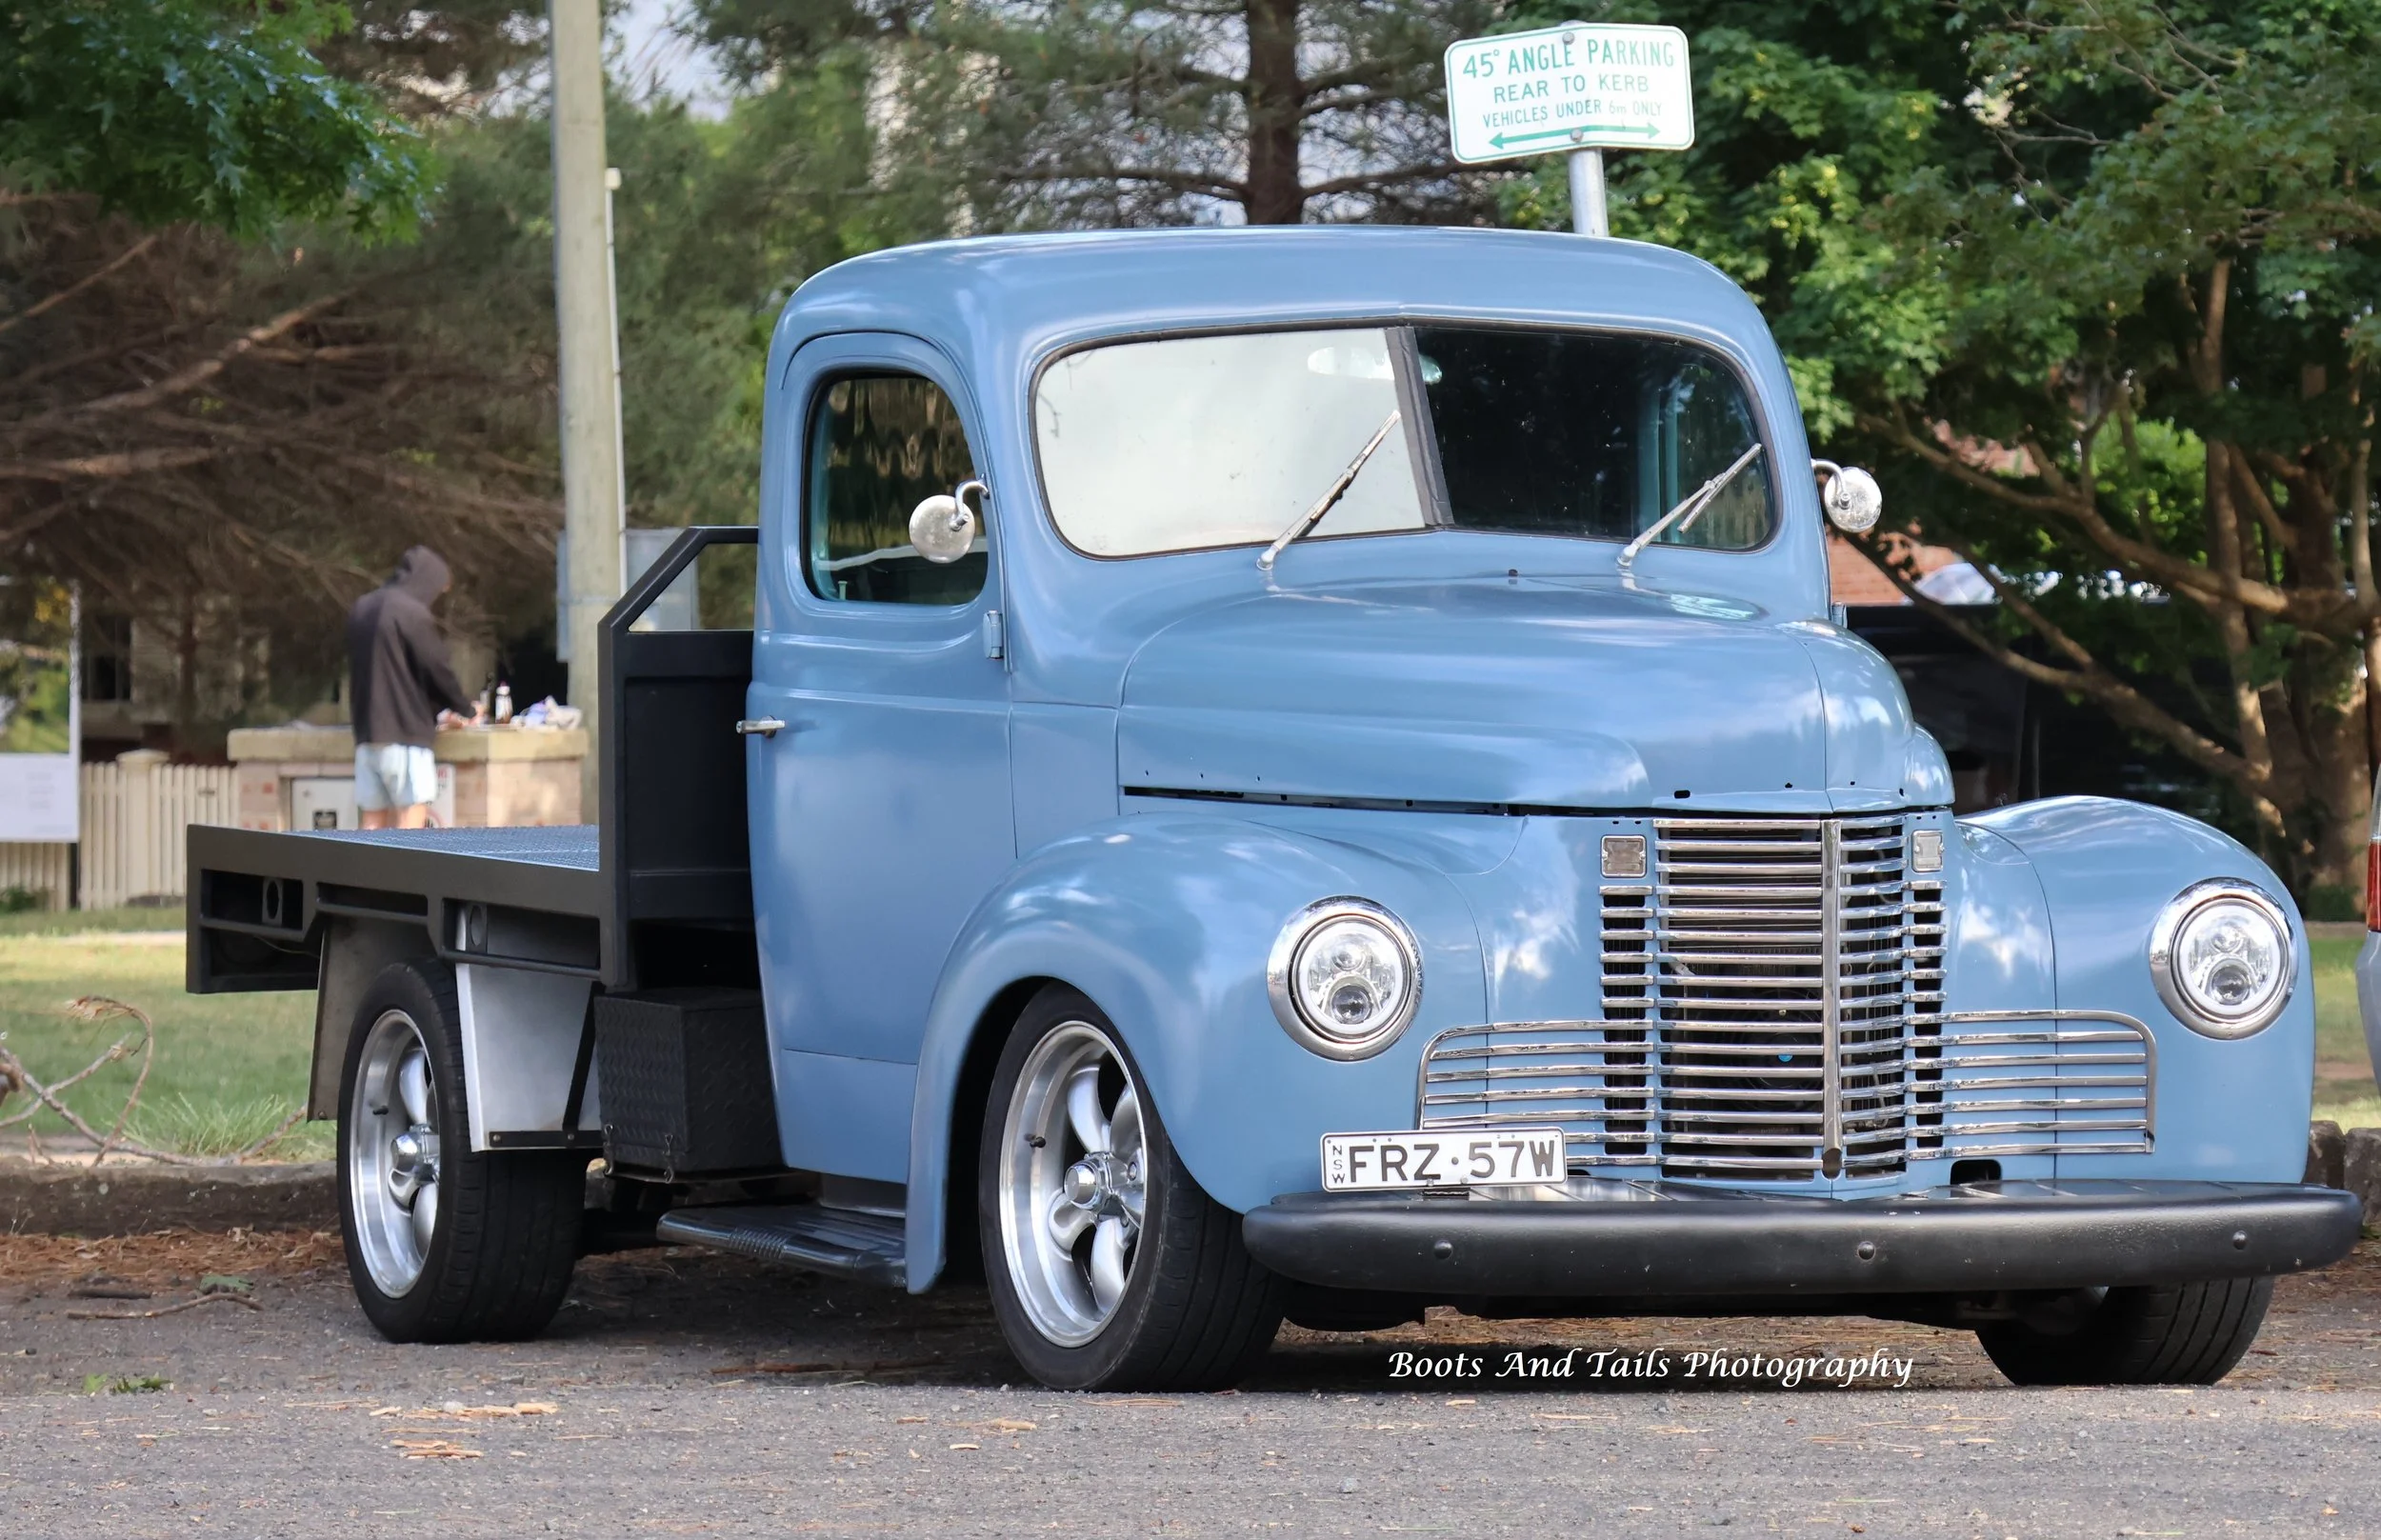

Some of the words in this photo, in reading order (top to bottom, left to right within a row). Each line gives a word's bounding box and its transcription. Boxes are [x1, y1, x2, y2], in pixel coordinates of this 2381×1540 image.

[1463, 50, 1500, 78] 45°
[1508, 44, 1575, 74] ANGLE
[1588, 39, 1674, 68] PARKING
[1493, 80, 1550, 103] REAR
[1561, 75, 1586, 92] TO
[1599, 73, 1650, 92] KERB
[1483, 106, 1549, 128] VEHICLES
[1556, 99, 1602, 119] UNDER
[1609, 100, 1627, 114] 6m
[1632, 102, 1662, 116] ONLY
[1331, 1145, 1346, 1184] NSW
